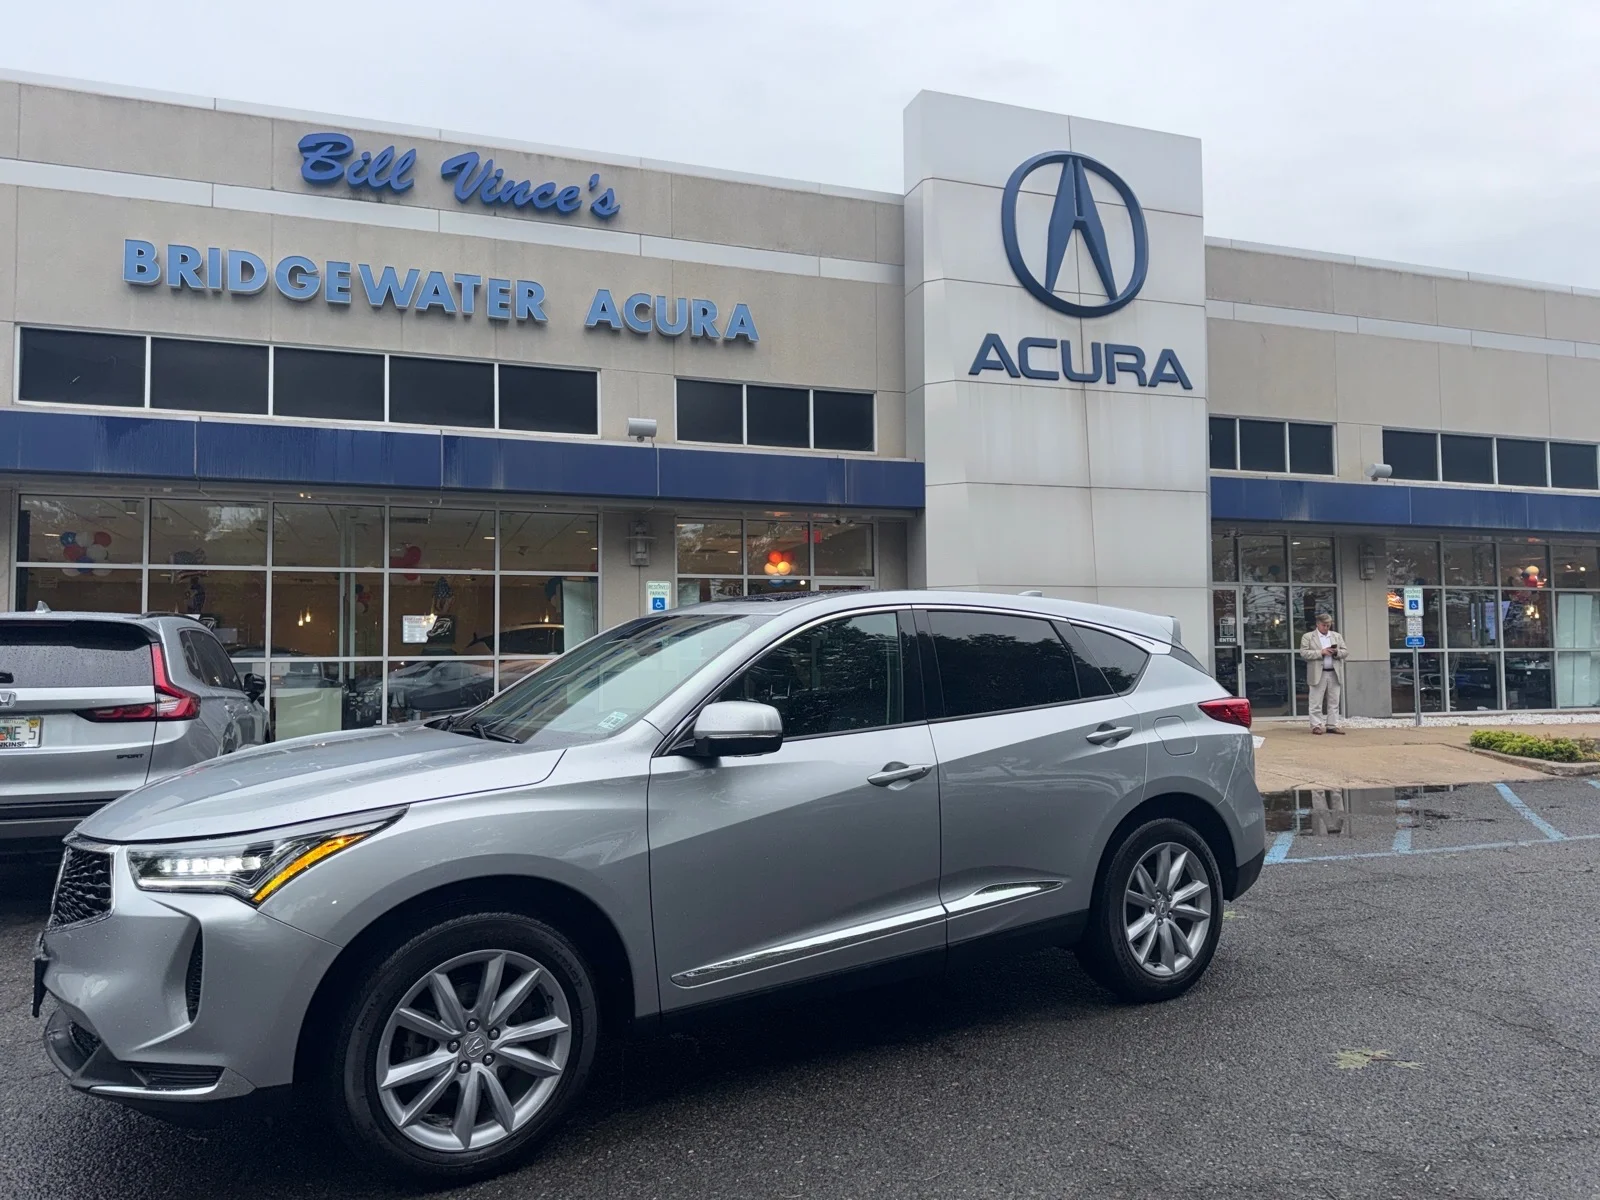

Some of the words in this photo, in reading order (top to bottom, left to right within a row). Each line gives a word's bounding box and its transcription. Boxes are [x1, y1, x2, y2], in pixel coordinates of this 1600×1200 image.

[298, 132, 417, 193] Bill
[441, 151, 620, 219] Vince's
[122, 238, 549, 323] BRIDGEWATER
[584, 288, 760, 343] ACURA
[968, 333, 1193, 390] ACURA
